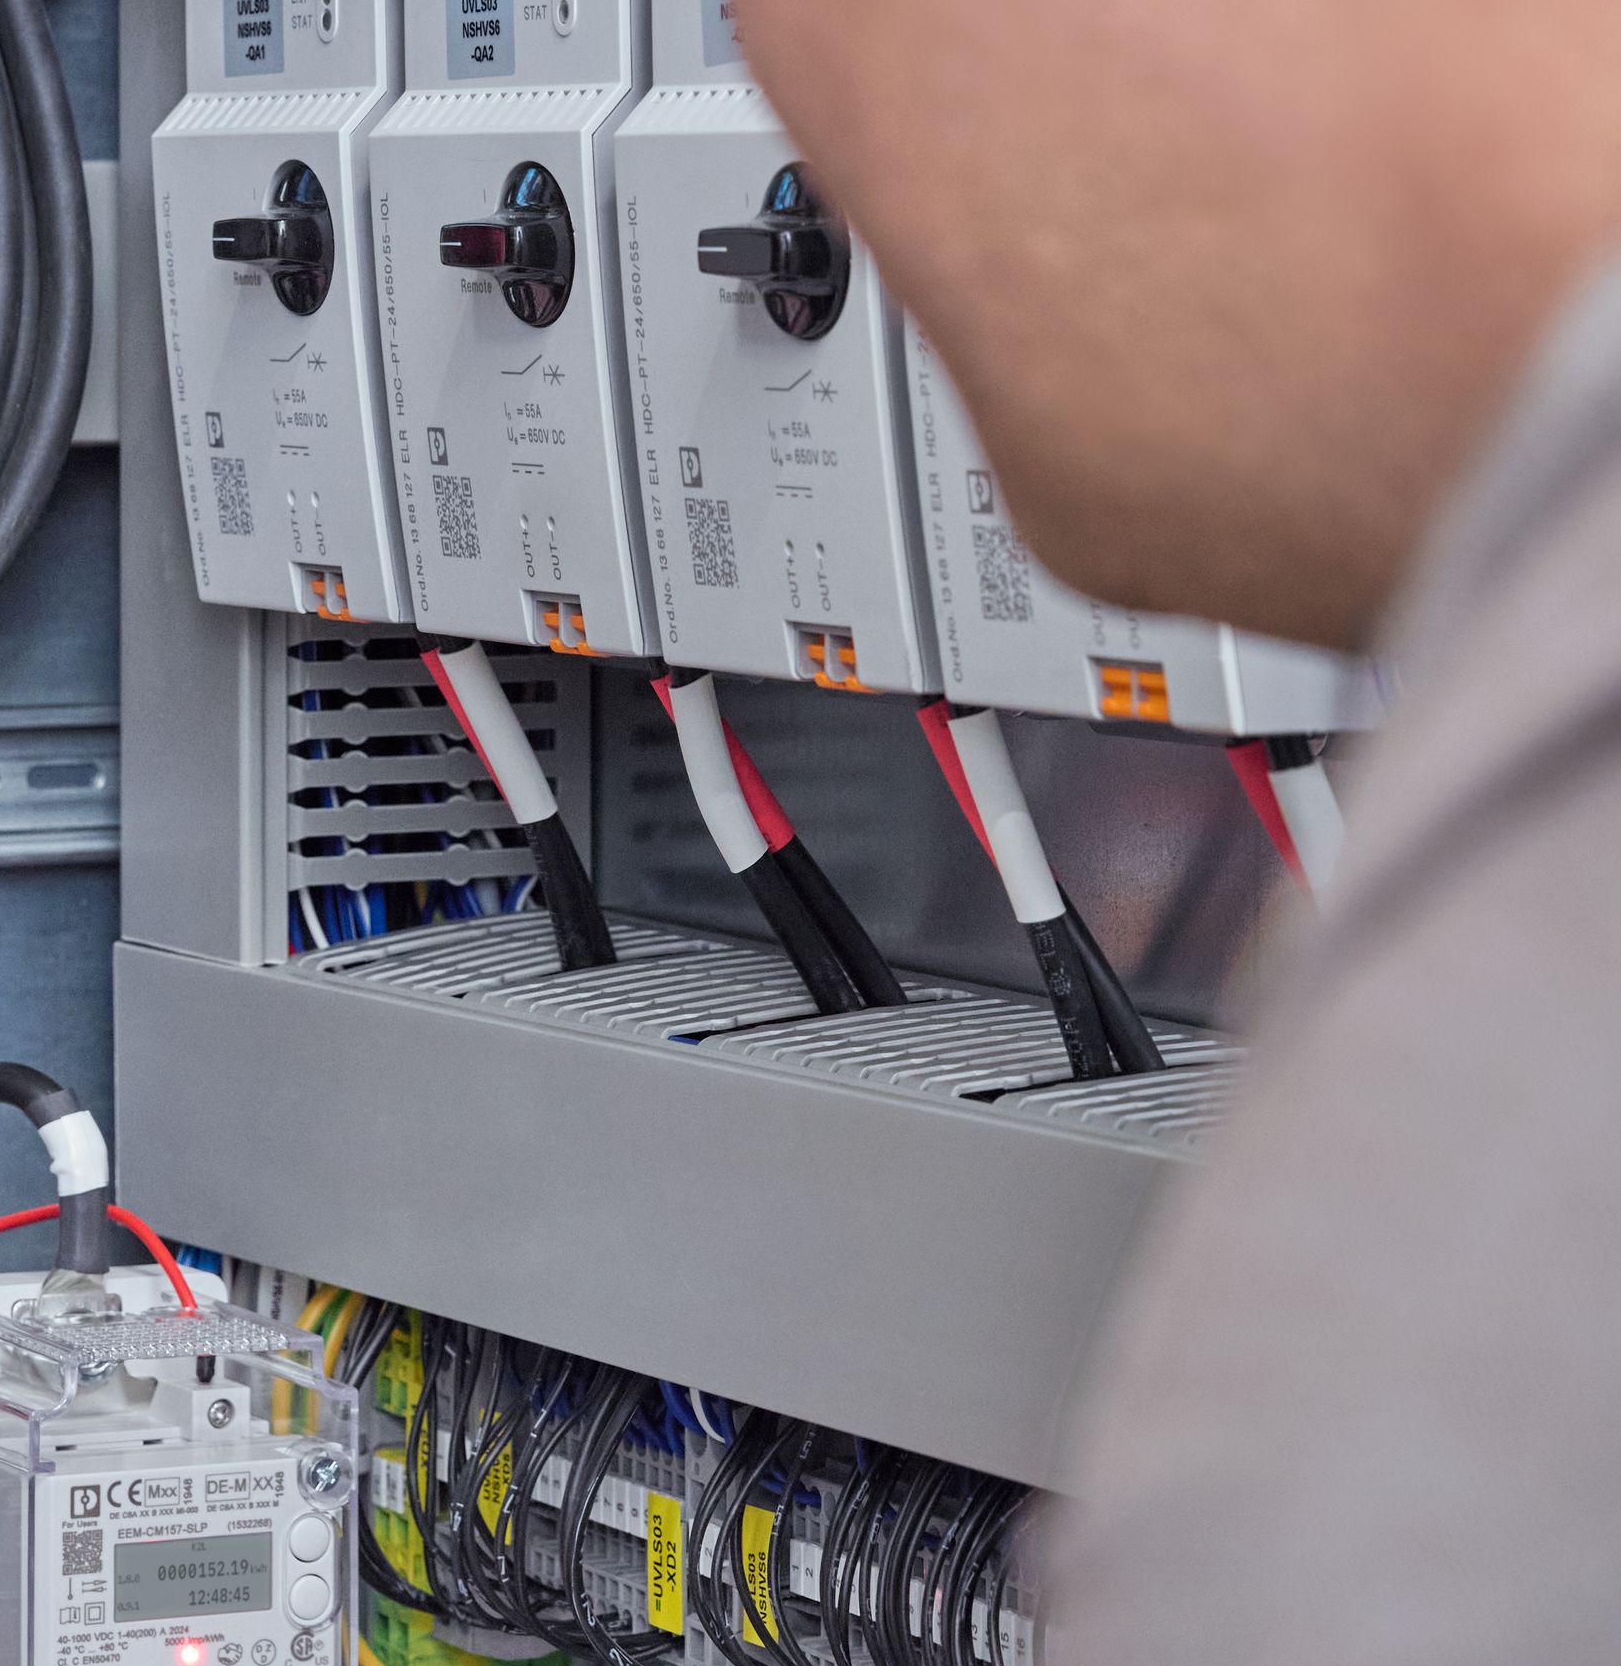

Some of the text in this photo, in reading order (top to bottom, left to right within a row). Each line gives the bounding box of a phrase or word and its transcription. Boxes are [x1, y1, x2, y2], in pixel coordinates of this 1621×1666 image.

[524, 5, 547, 20] STAT
[238, 21, 272, 38] NSHVS6
[292, 15, 312, 29] STAT
[463, 20, 500, 38] NSHVS6
[246, 45, 265, 61] -QA1
[471, 45, 493, 62] -QA2
[234, 271, 261, 286] Remote
[461, 278, 492, 294] Remote
[720, 288, 755, 304] Remote
[402, 430, 410, 463] ELR
[649, 449, 659, 485] ELR
[405, 473, 414, 494] 127
[524, 529, 535, 578] OUT+
[149, 1484, 177, 1498] Mxx
[208, 1478, 247, 1494] DE-M
[118, 1518, 272, 1539] EEM-CM157-SLP (1532268)
[158, 1560, 249, 1581] 0000152.19
[652, 1513, 662, 1612] =UVLS03
[666, 1541, 676, 1592] -XD2
[189, 1586, 250, 1606] 12:48:45
